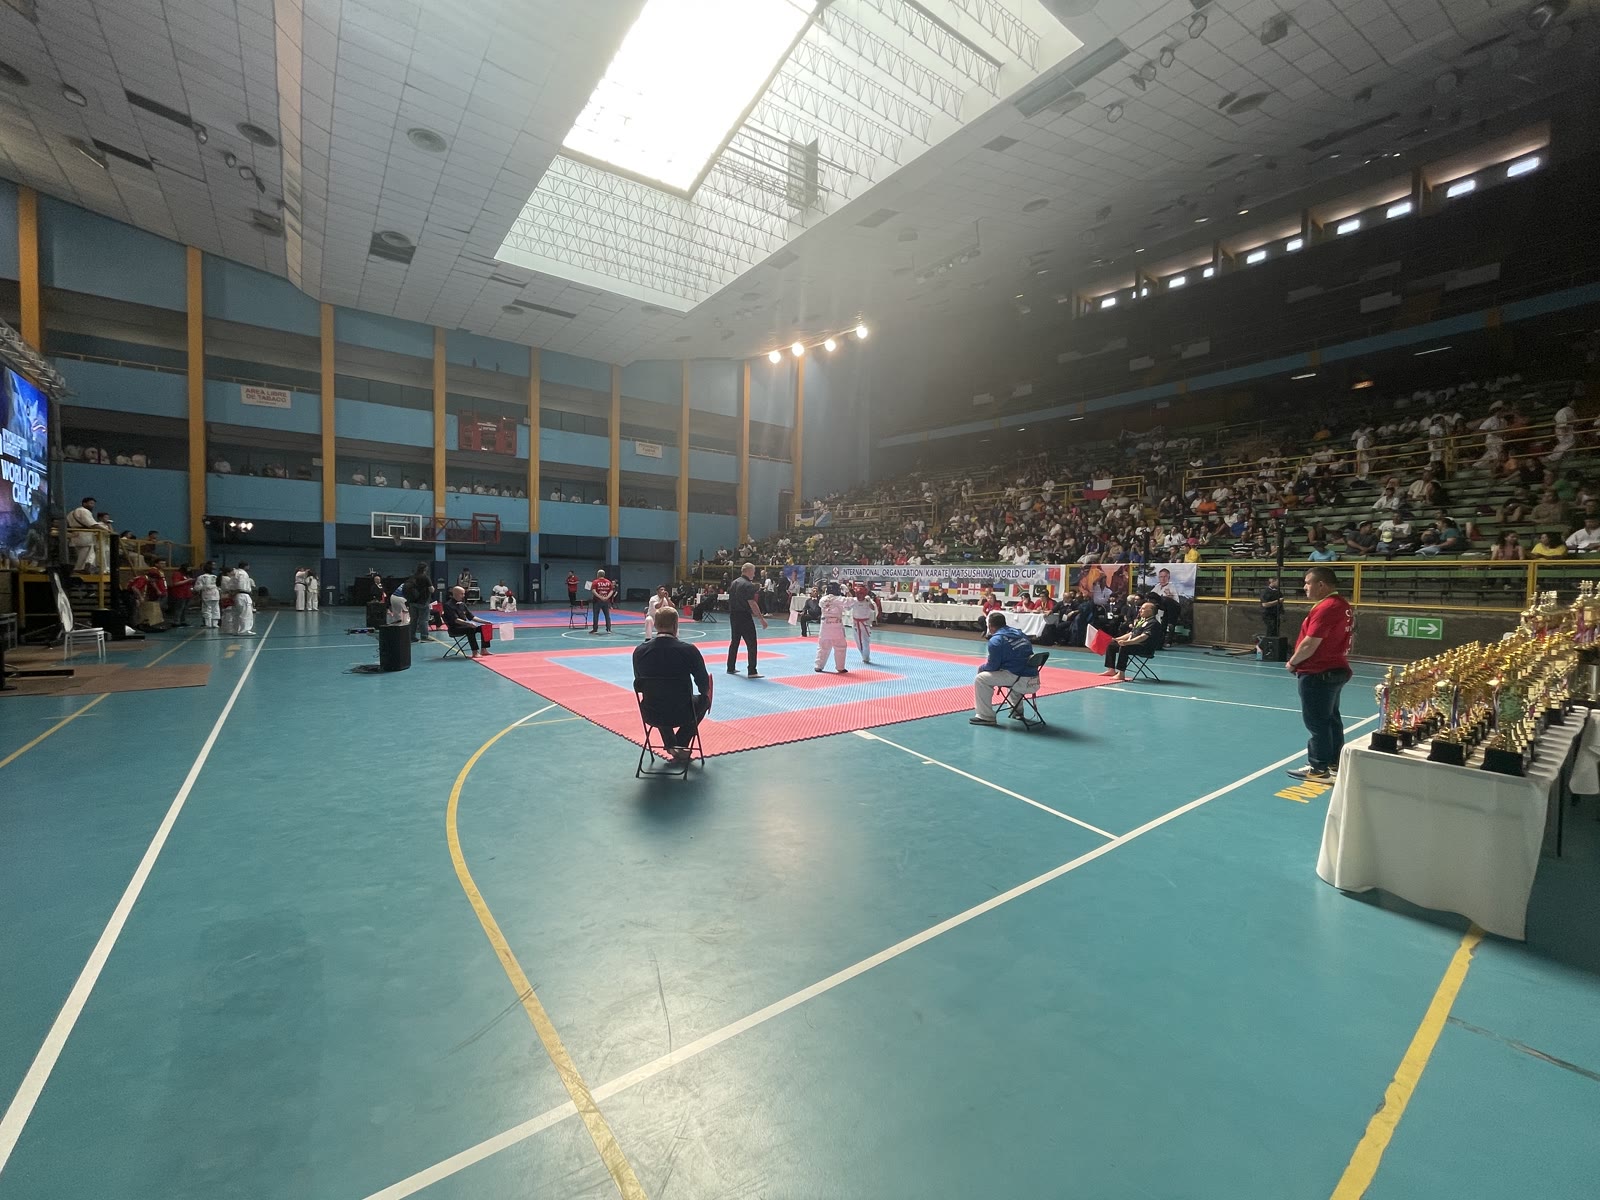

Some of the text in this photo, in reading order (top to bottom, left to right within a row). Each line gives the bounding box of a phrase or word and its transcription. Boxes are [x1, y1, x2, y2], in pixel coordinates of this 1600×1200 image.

[1, 459, 28, 487] WORLD
[28, 470, 40, 491] CUP
[13, 482, 32, 506] CHILE
[843, 568, 1037, 578] INTERNATIONAL ORGANIZATION KARATE MATSUSHIMA WORLD CUP
